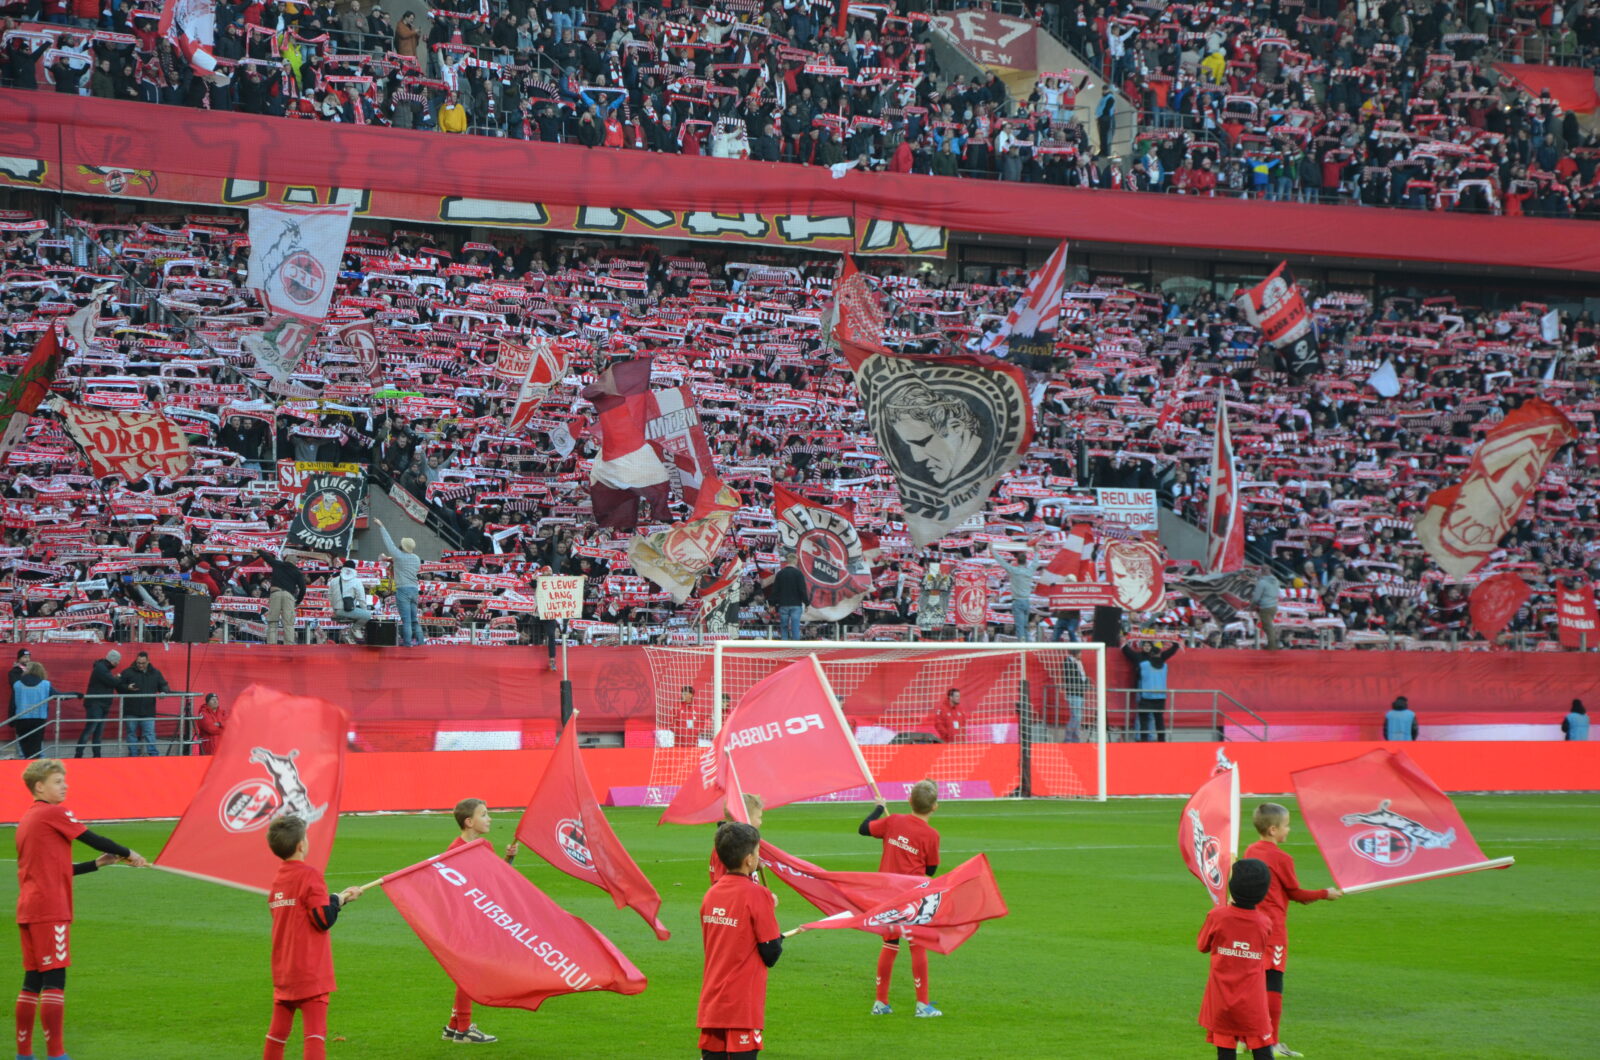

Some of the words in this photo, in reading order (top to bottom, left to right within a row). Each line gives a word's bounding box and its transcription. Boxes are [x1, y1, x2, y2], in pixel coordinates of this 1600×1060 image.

[313, 477, 356, 495] JUNGE
[1101, 490, 1154, 505] REDLINE
[1103, 511, 1155, 525] COLOGNE
[296, 531, 343, 550] HORDE
[541, 581, 548, 590] E
[549, 591, 573, 600] LANG
[546, 600, 577, 610] ULTRAS
[565, 610, 575, 619] FC
[897, 836, 910, 844] FC
[566, 848, 588, 863] KÖLN
[274, 891, 284, 900] FC
[712, 907, 726, 916] FC
[1233, 940, 1250, 951] FC
